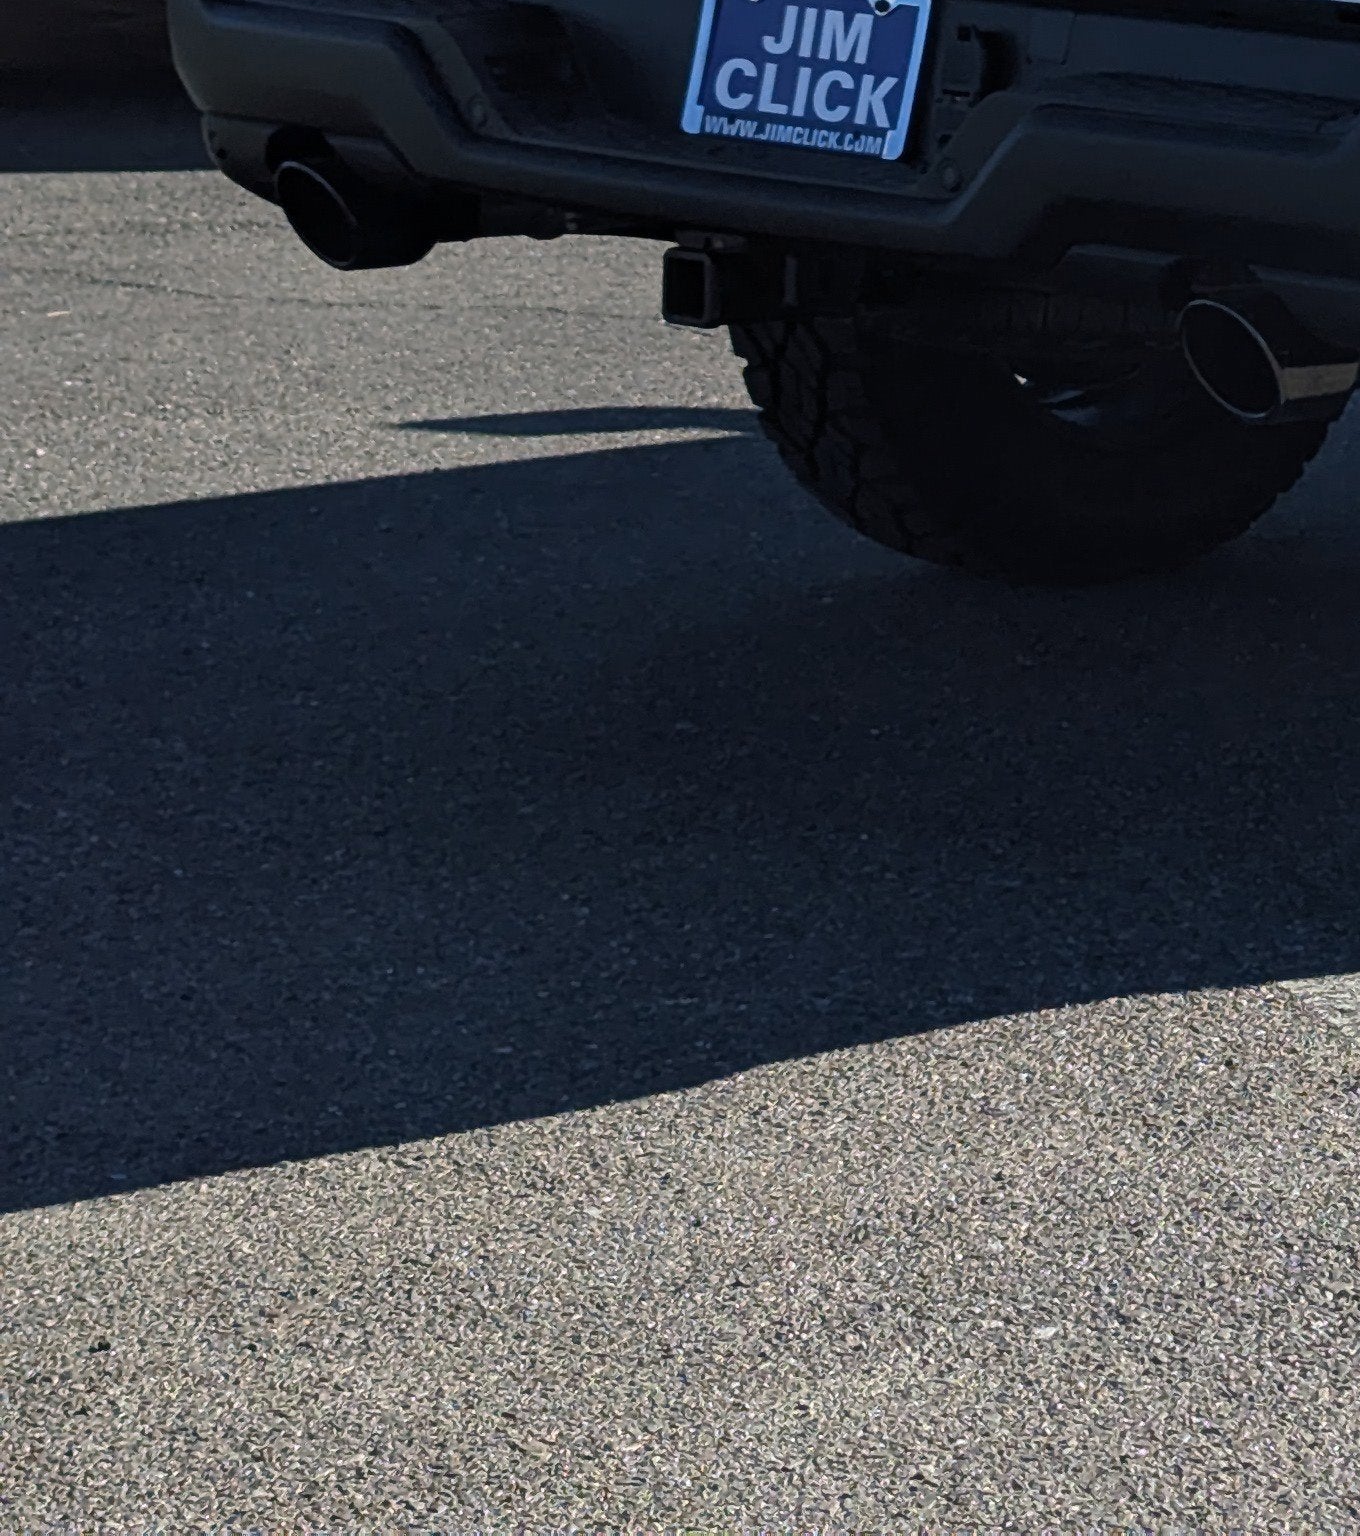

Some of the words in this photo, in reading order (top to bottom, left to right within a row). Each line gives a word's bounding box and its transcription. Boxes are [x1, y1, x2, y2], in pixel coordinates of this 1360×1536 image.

[762, 5, 875, 65] JIM
[714, 58, 900, 129] CLICK
[704, 114, 883, 156] WWW.JIMCLICK.COM
